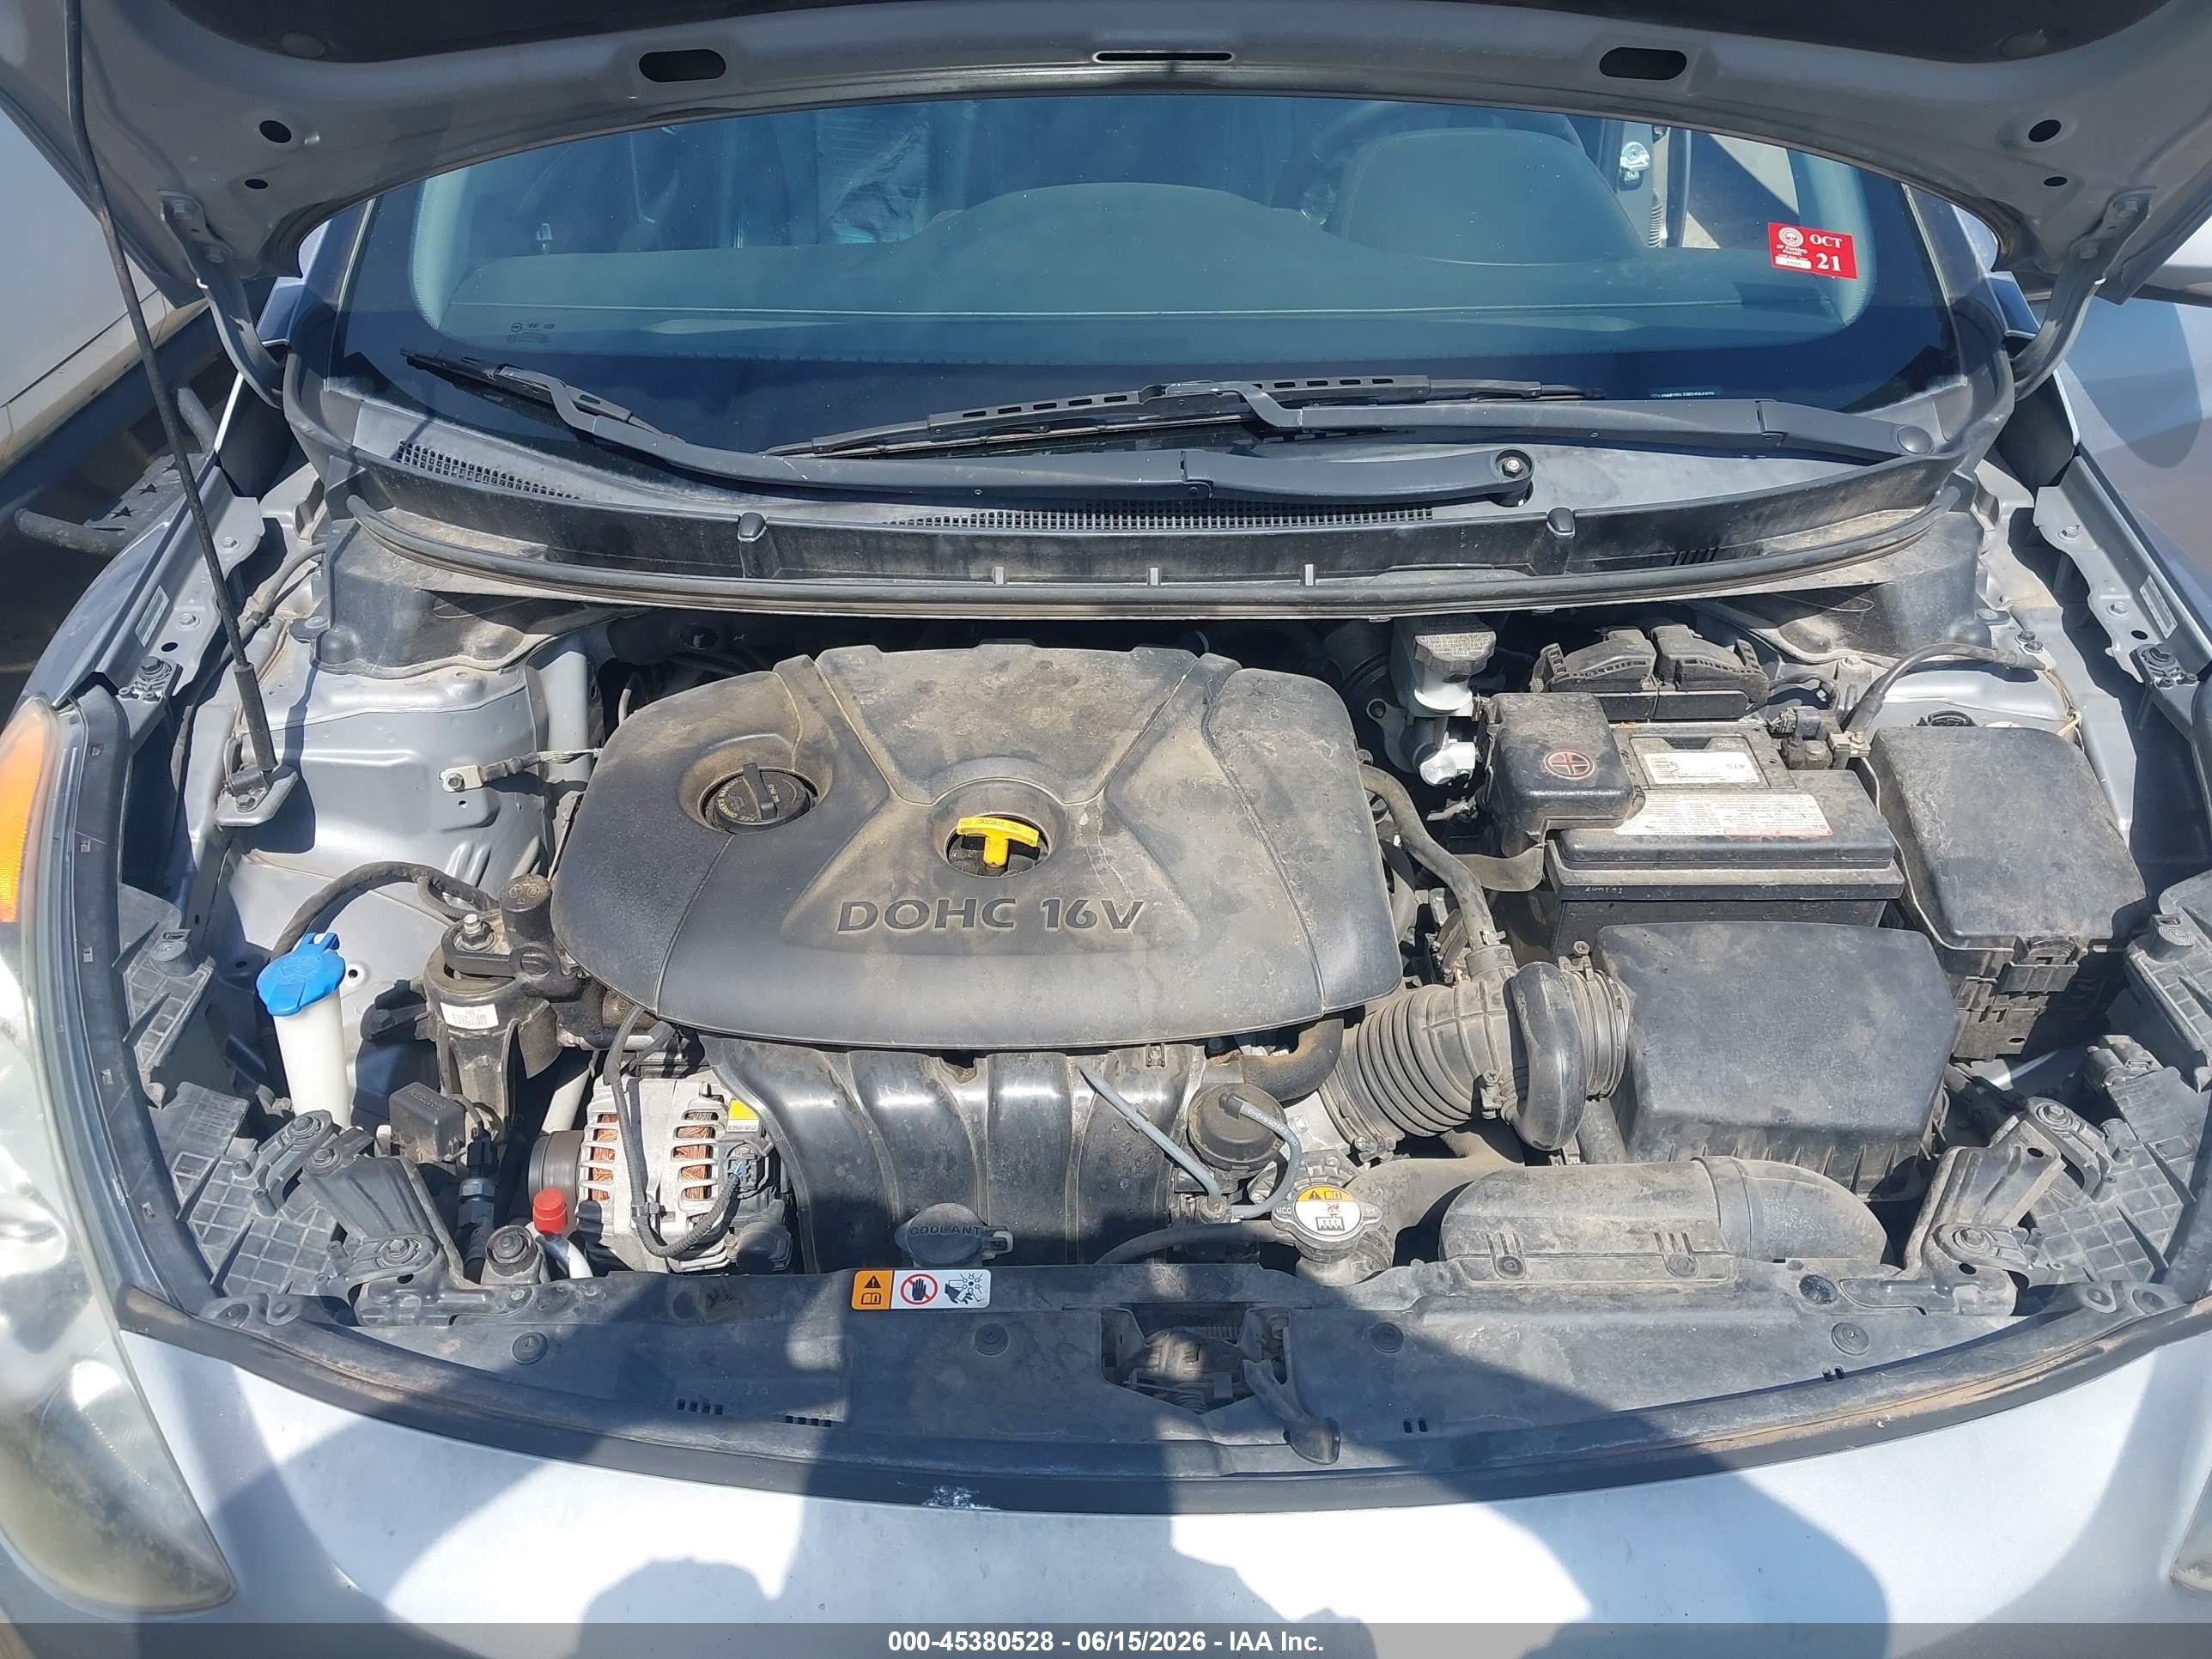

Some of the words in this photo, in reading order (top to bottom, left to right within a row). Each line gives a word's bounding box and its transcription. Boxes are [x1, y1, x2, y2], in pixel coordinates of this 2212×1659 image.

[1809, 234, 1843, 248] OCT
[1815, 252, 1841, 272] 21
[836, 898, 1018, 934] DOHC
[1041, 897, 1145, 933] 16V
[909, 1224, 981, 1237] COOLANT
